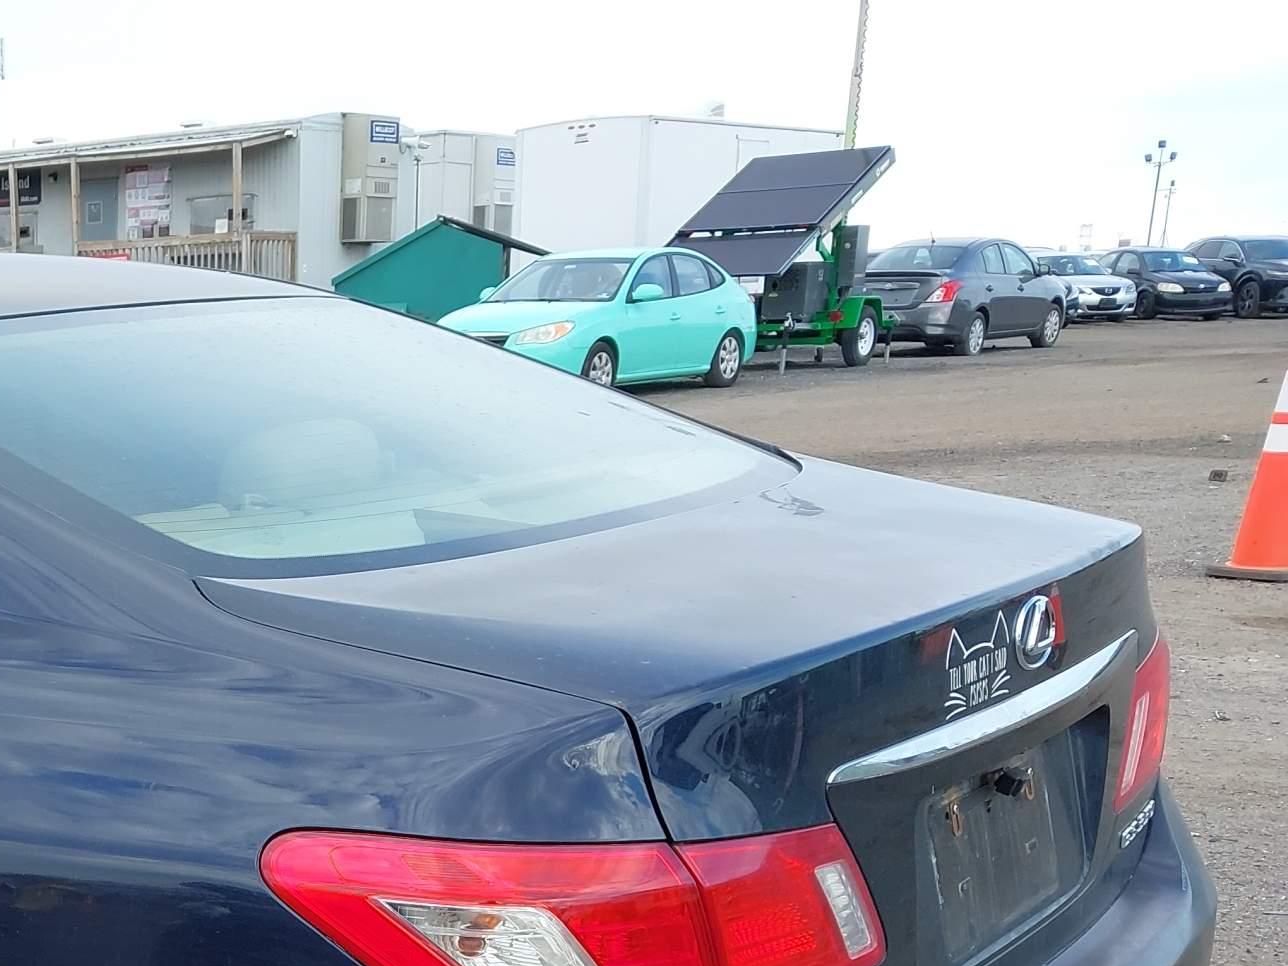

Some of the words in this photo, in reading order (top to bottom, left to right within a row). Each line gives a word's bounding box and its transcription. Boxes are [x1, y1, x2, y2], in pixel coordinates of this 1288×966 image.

[1, 175, 30, 190] Isnd
[949, 665, 962, 691] TELL
[963, 660, 977, 685] YOUR
[978, 653, 990, 679] CAT
[994, 647, 1007, 672] SAID
[969, 678, 989, 707] PSPSPS
